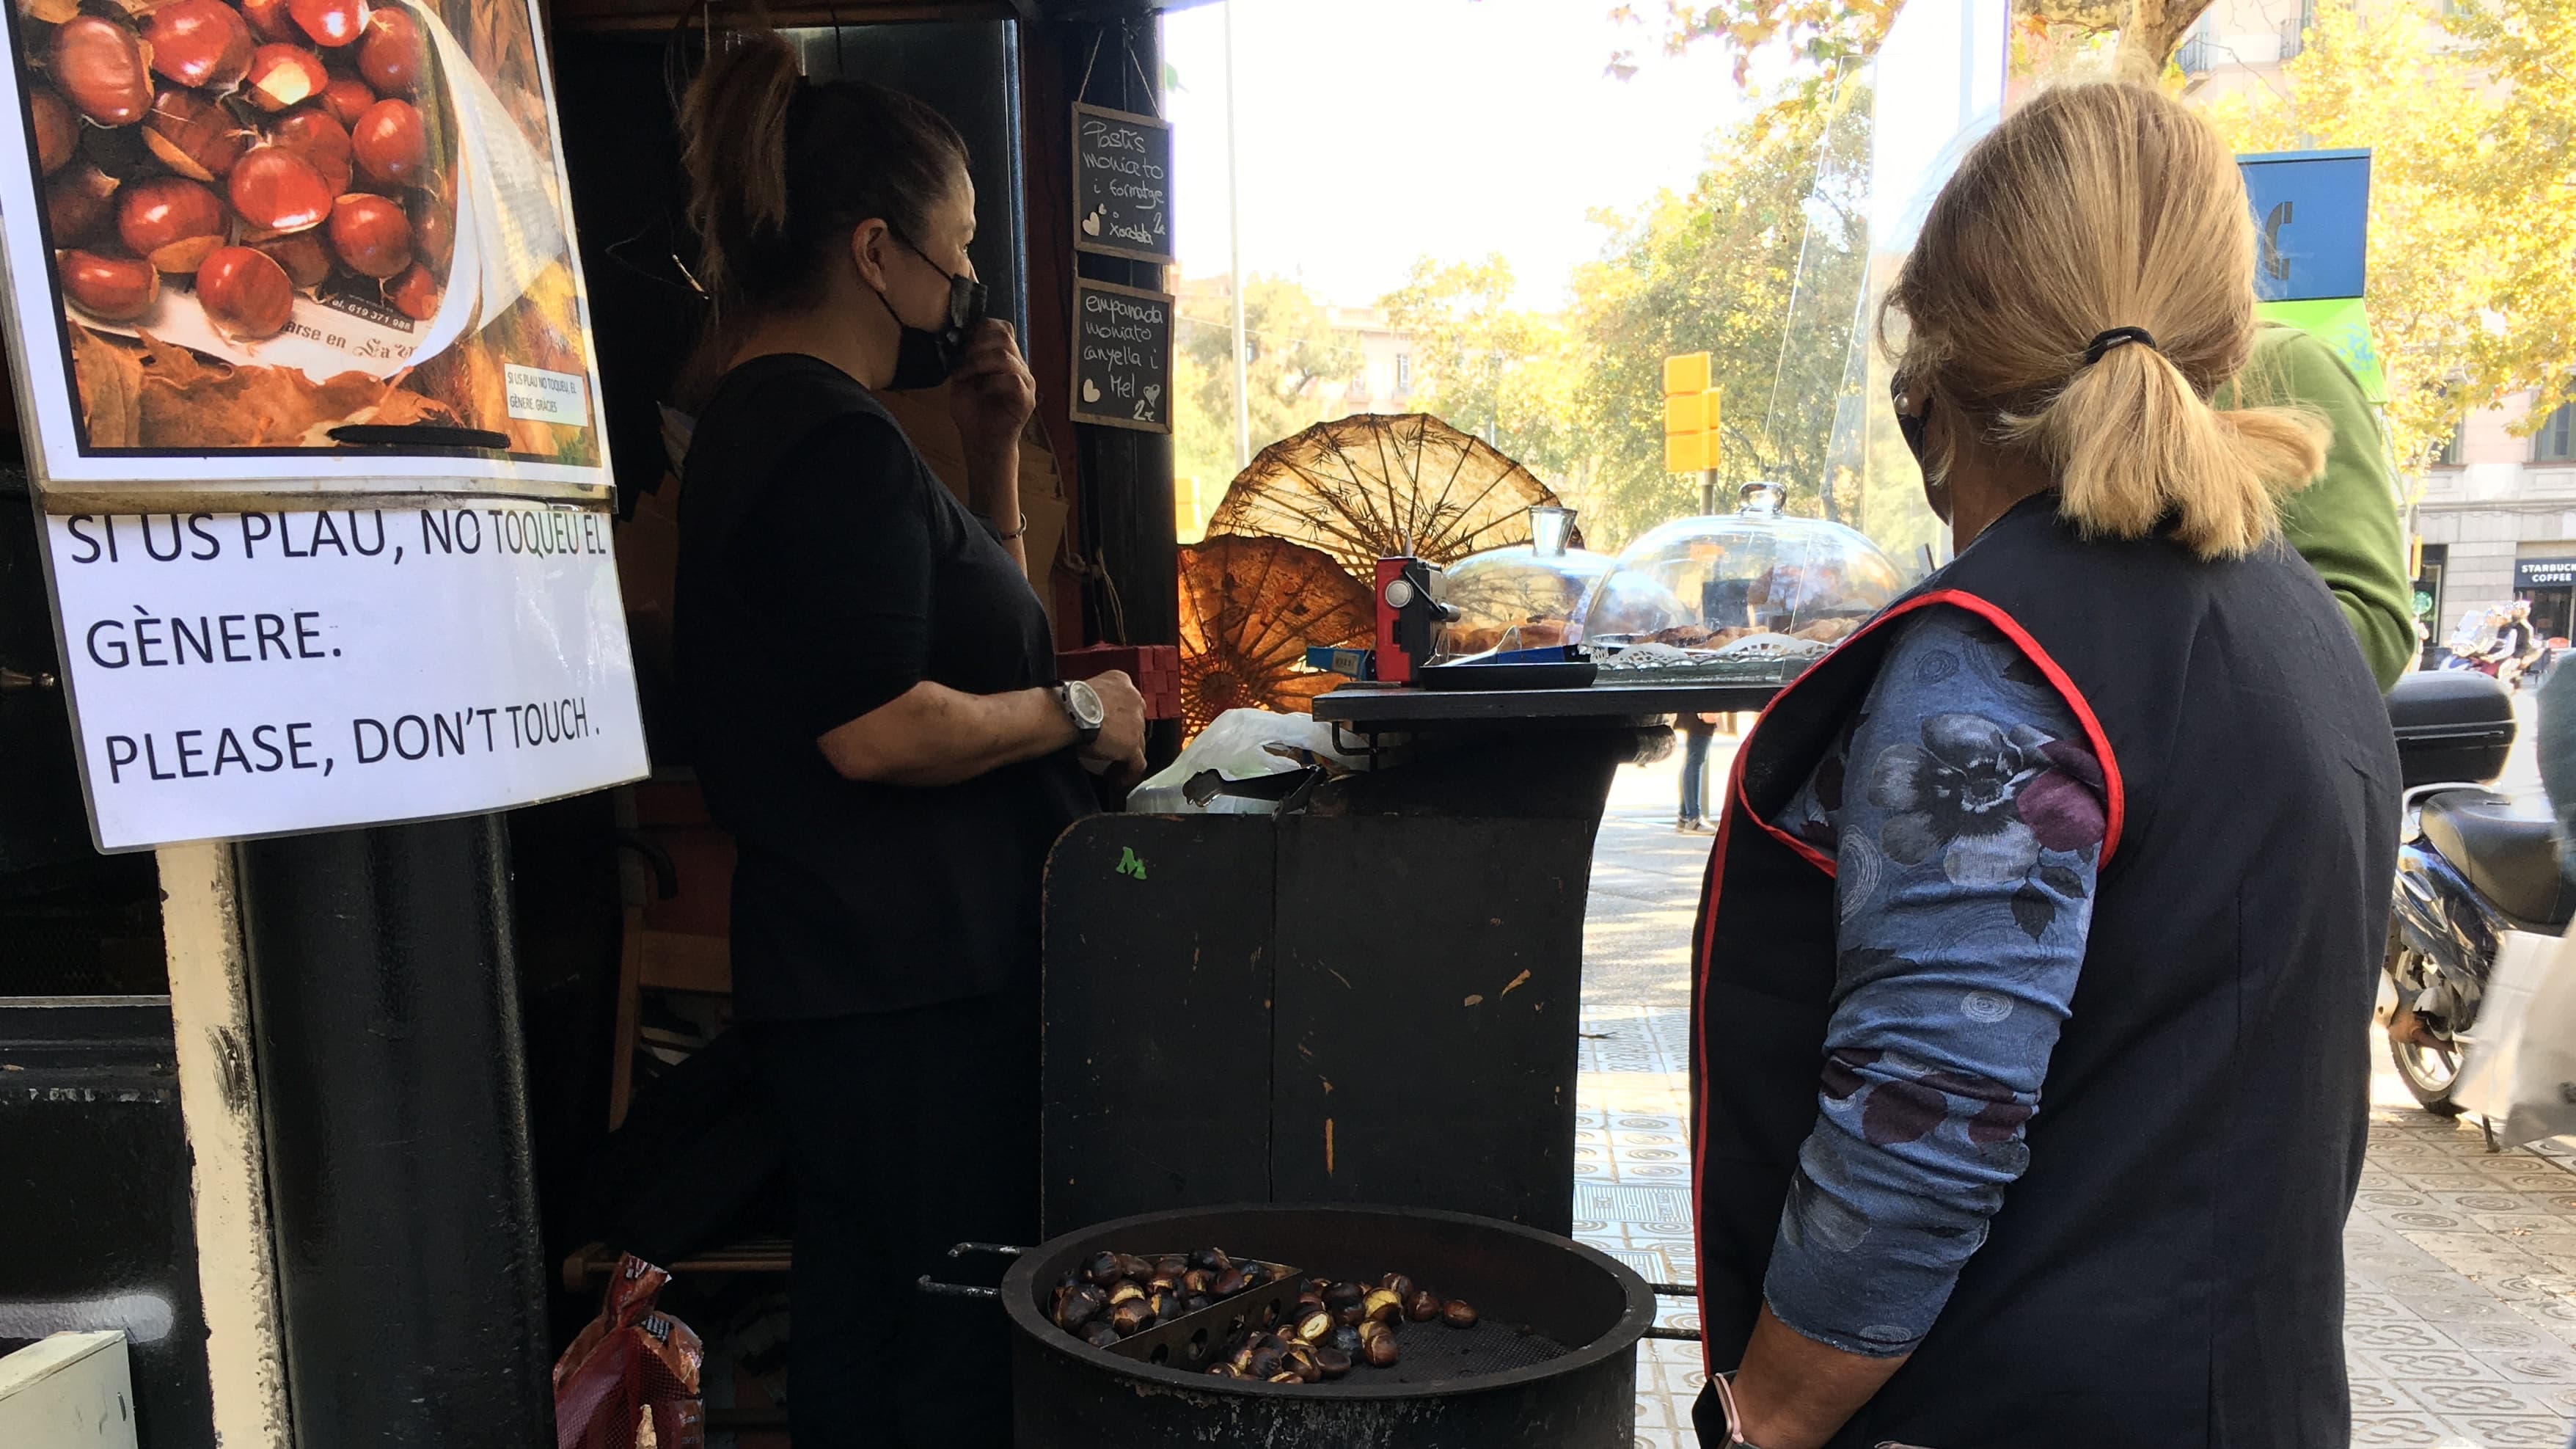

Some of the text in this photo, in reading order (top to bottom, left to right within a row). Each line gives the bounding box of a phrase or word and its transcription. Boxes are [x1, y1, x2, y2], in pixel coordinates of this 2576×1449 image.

[1094, 178, 1101, 194] i
[330, 299, 345, 309] el.
[370, 310, 389, 324] 371
[1086, 296, 1163, 324] empanada
[280, 321, 347, 348] arse en
[1086, 321, 1152, 343] moniato
[1149, 348, 1158, 369] i
[524, 375, 538, 387] PLAU
[539, 376, 547, 390] NO
[571, 382, 577, 394] EL
[67, 509, 607, 565] SI US PLAU, NO TOQUEU EL
[2532, 573, 2572, 583] COFFEE
[87, 605, 341, 669] GÈNERE.
[106, 722, 334, 784] PLEASE,
[353, 707, 497, 764] DON'T
